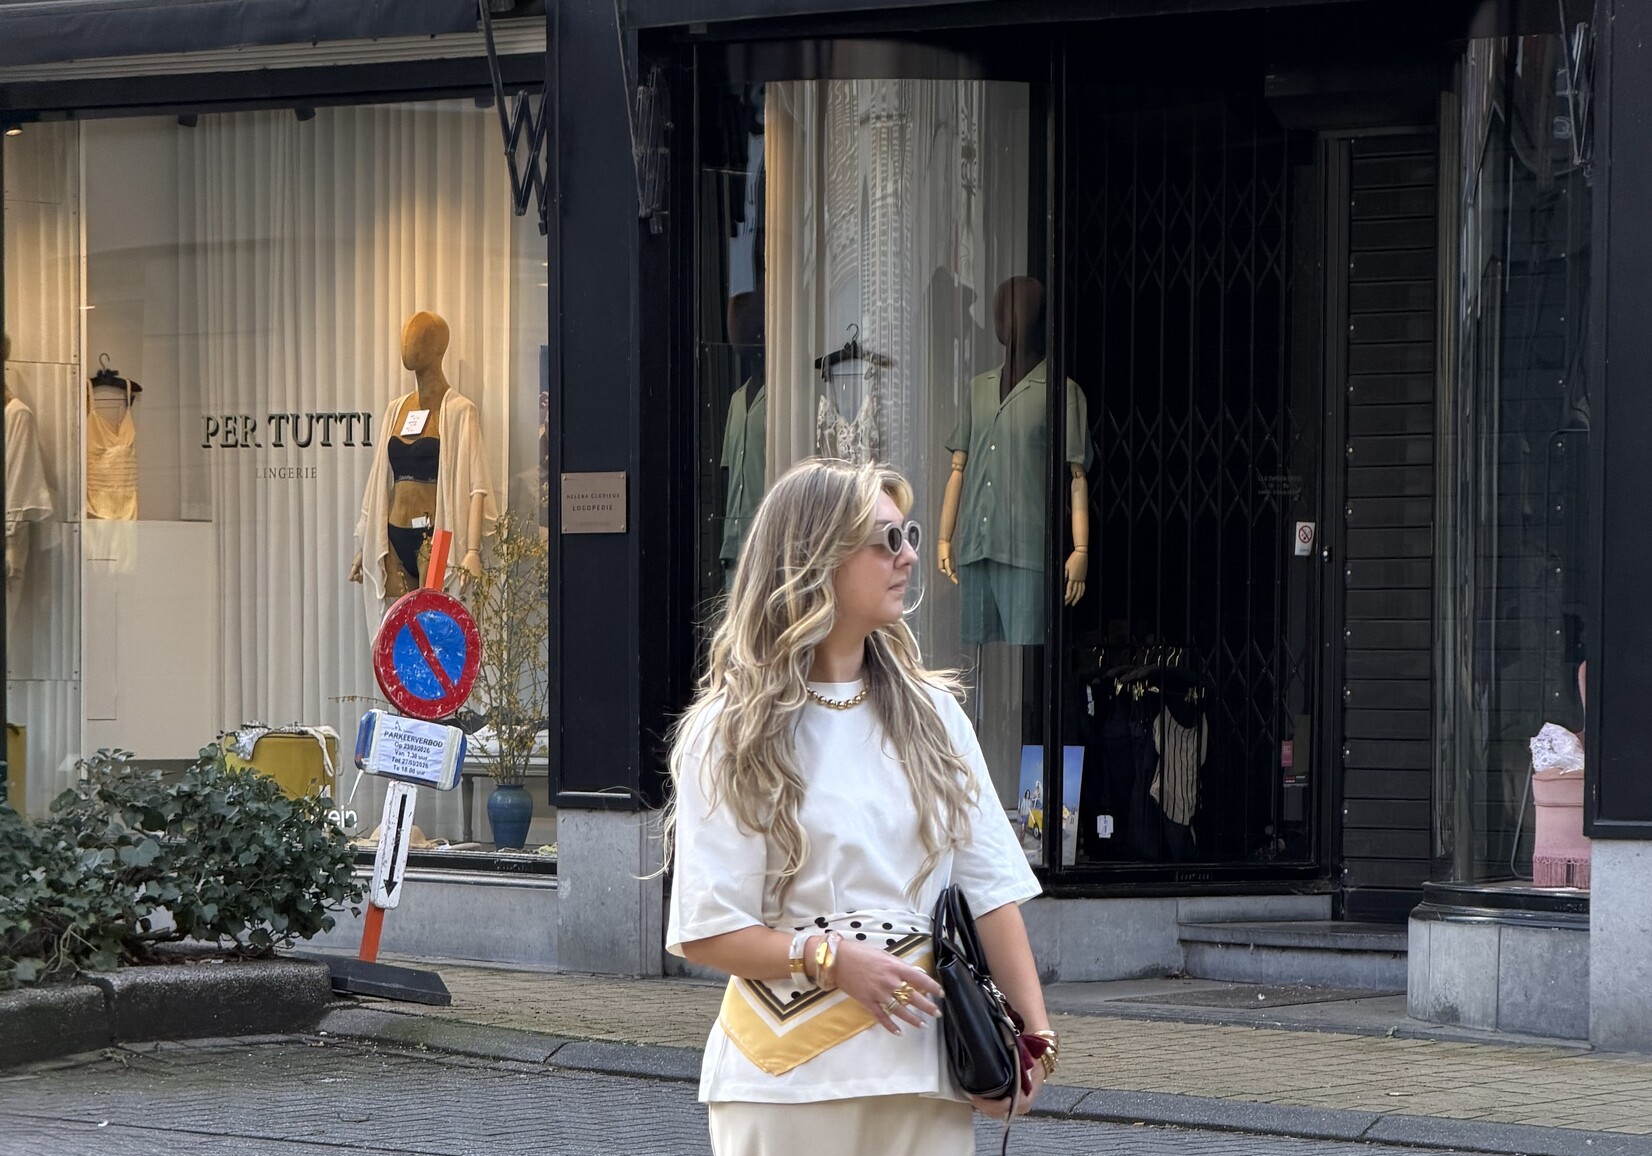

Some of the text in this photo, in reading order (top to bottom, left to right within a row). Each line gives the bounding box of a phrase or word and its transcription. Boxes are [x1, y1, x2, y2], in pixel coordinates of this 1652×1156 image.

[201, 414, 262, 449] PER
[267, 412, 373, 448] TUTTI
[256, 466, 317, 479] LINGERIE
[572, 504, 613, 512] LOGOPEDIE
[384, 731, 443, 748] PARKEERVERBOD
[394, 741, 403, 750] Op
[394, 748, 405, 756] Van
